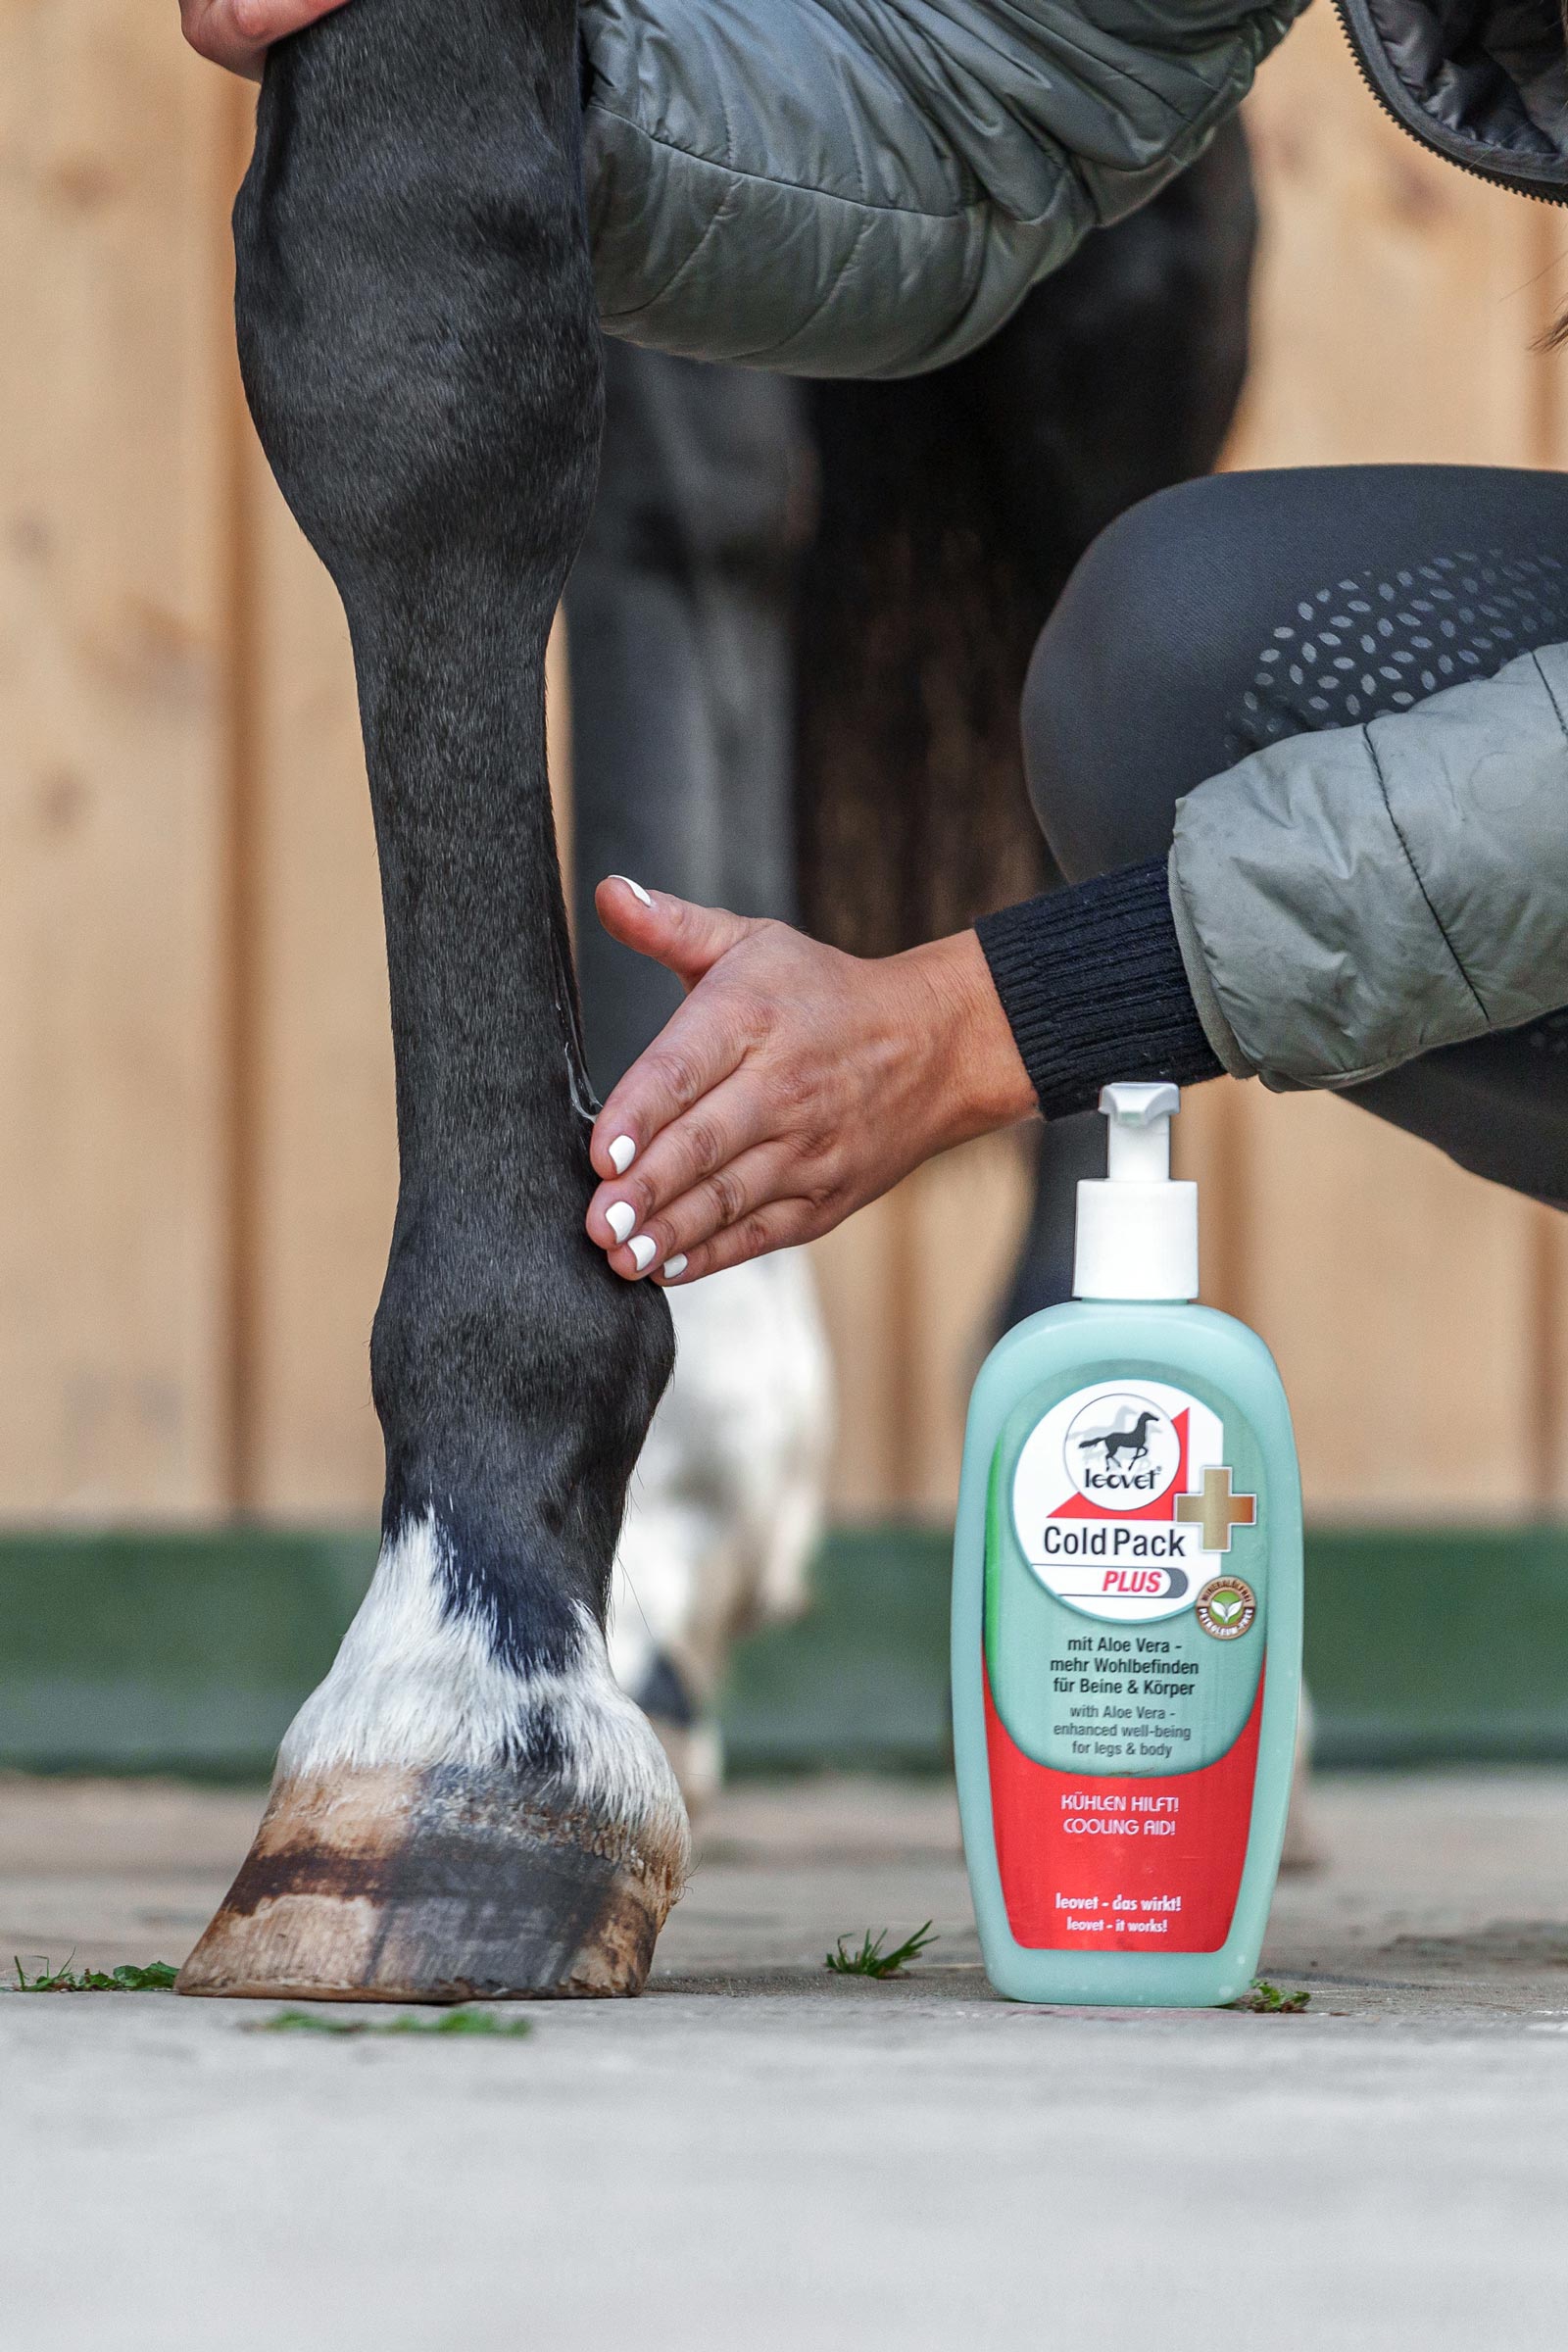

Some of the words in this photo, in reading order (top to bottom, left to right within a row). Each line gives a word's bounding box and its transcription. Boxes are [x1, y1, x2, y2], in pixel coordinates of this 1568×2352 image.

[1044, 1526, 1106, 1555] Cold
[1113, 1529, 1186, 1556] Pack
[1102, 1570, 1162, 1592] PLUS
[1067, 1637, 1094, 1652] mit
[1097, 1638, 1133, 1652] Aloe
[1136, 1638, 1170, 1653] Vera
[1050, 1657, 1090, 1673] mehr
[1094, 1657, 1200, 1675] Wohlbefinden
[1053, 1678, 1075, 1692] für
[1080, 1679, 1123, 1693] Beine
[1127, 1680, 1140, 1694] &
[1144, 1680, 1196, 1697] Körper
[1070, 1704, 1100, 1718] with
[1102, 1705, 1133, 1719] Aloe
[1136, 1706, 1166, 1720] Vera
[1053, 1723, 1118, 1738] enhanced
[1121, 1724, 1192, 1741] well-being
[1072, 1741, 1091, 1754] for
[1094, 1742, 1122, 1757] legs
[1125, 1743, 1136, 1755] &
[1140, 1742, 1173, 1758] body
[1060, 1791, 1127, 1811] KÜHLEN
[1130, 1796, 1179, 1813] HILFT!
[1062, 1818, 1140, 1836] COOLING
[1143, 1820, 1176, 1837] AID!
[1055, 1892, 1099, 1909] leovet
[1111, 1894, 1138, 1911] das
[1141, 1894, 1182, 1912] wirkt!
[1066, 1917, 1104, 1932] leovet
[1115, 1919, 1125, 1933] it
[1127, 1919, 1168, 1934] works!
